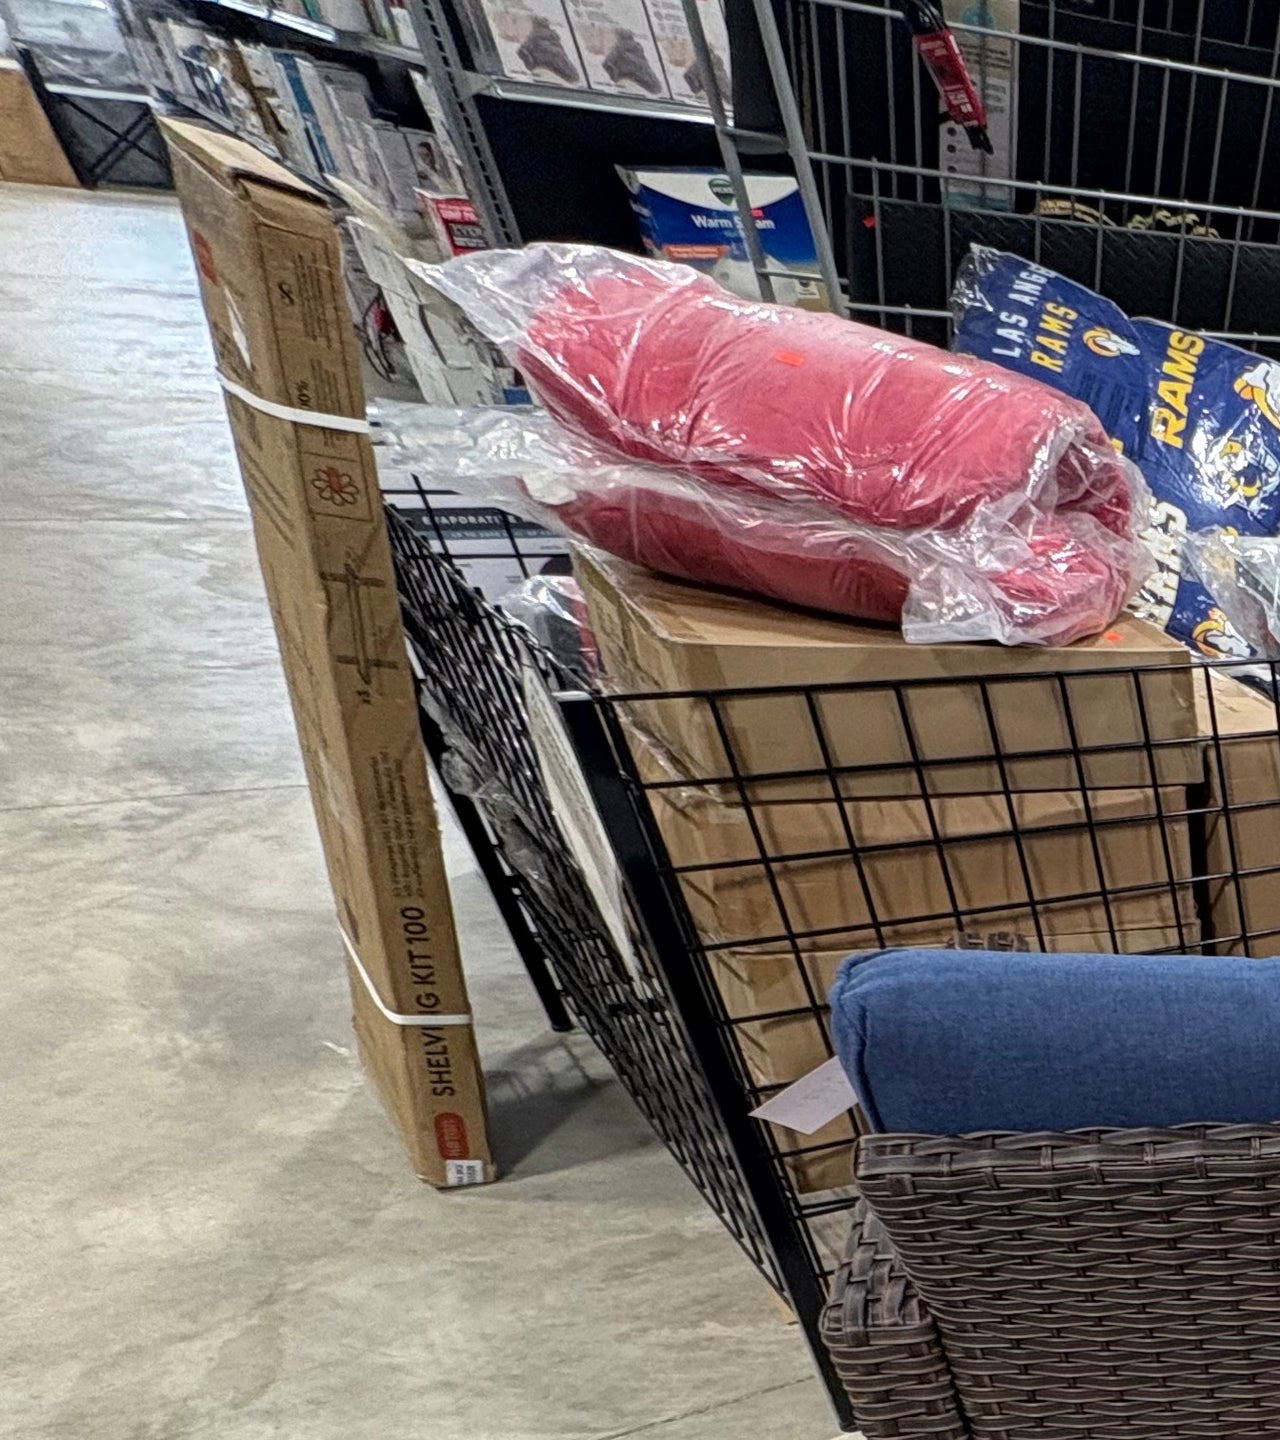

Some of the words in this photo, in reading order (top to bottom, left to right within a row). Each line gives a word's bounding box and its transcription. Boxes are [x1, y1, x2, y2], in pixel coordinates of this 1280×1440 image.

[690, 214, 733, 230] Warm
[735, 217, 776, 230] Sam
[992, 312, 1029, 358] LAS
[1030, 301, 1080, 373] RAMS
[1151, 330, 1207, 450] RAMS
[401, 906, 430, 947] 100
[407, 949, 437, 986] KIT
[415, 991, 456, 1097] SHELVIG
